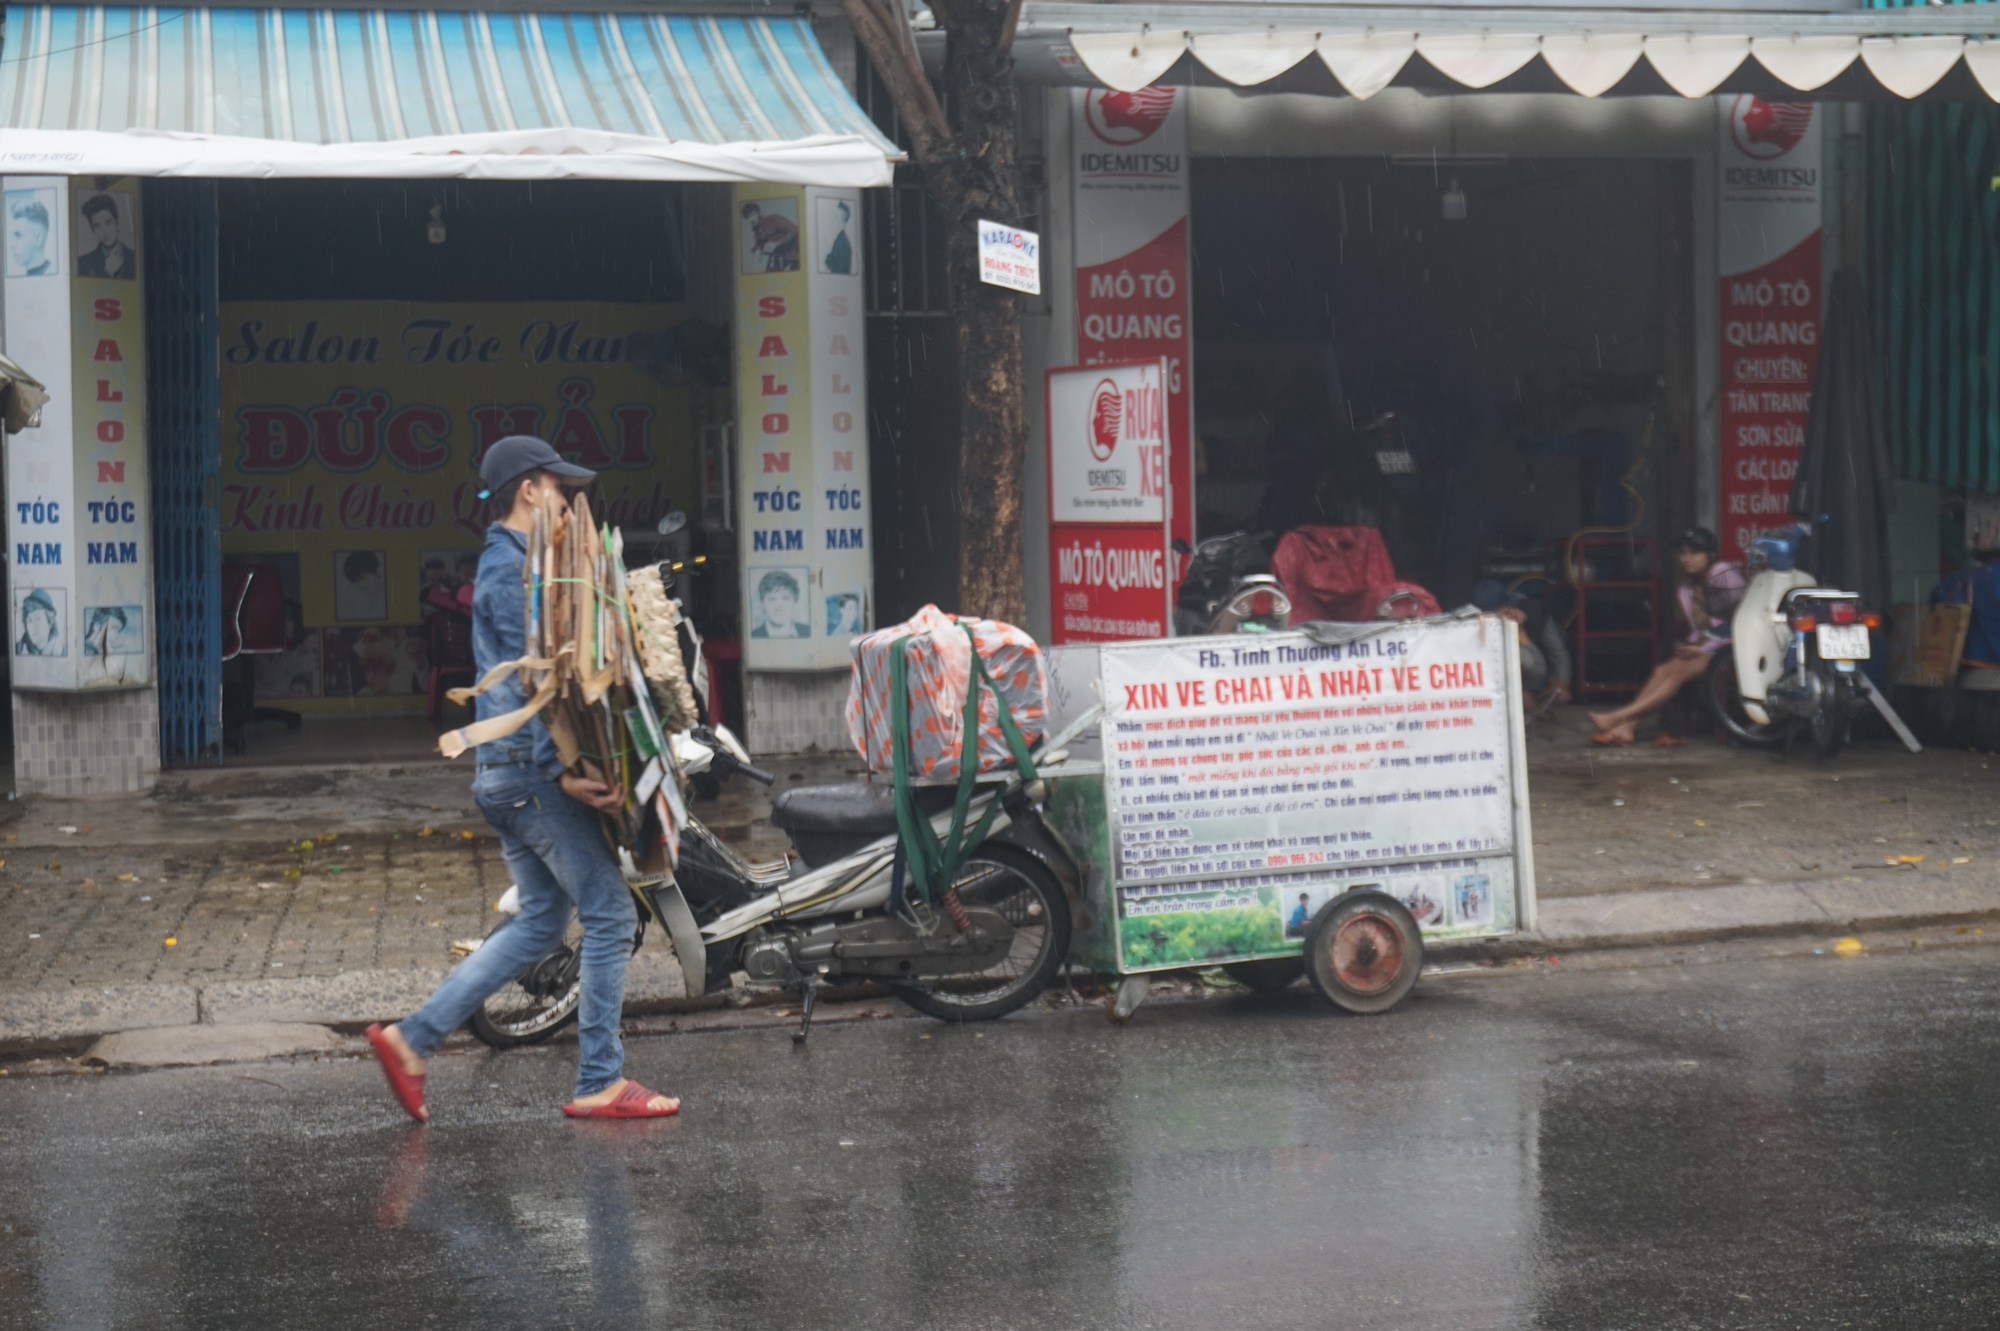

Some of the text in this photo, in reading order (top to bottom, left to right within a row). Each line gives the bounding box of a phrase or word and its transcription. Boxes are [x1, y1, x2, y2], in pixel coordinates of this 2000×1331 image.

[1081, 154, 1180, 173] IDEMITSU
[1726, 168, 1817, 186] IDEMITSU
[982, 231, 1036, 257] KARAOKE
[1090, 270, 1177, 299] MÔ TÔ
[1732, 277, 1811, 306] MÔ TÔ
[226, 318, 630, 366] Salon Tóc Na
[1084, 314, 1183, 342] QUANG
[1726, 320, 1817, 347] QUANG
[1735, 354, 1808, 380] CHUYÊN:
[94, 298, 126, 483] SALON
[758, 296, 791, 473] SALON
[828, 295, 854, 472] SALON
[1125, 367, 1162, 440] RỬA
[1729, 389, 1759, 413] TÂN
[238, 376, 656, 474] ĐỨC HẢI
[1737, 419, 1805, 447] SƠN SỬA
[1088, 470, 1127, 486] IDEMITSU
[1138, 446, 1163, 497] XE
[1737, 455, 1769, 480] CÁC
[17, 495, 60, 524] TÓC
[87, 495, 136, 524] TÓC
[222, 482, 328, 533] Kính
[337, 481, 441, 532] Chào
[753, 485, 801, 513] TÓC
[826, 484, 862, 511] TÓC
[1730, 494, 1748, 514] XE
[87, 542, 138, 564] NAM
[753, 529, 804, 552] NAM
[826, 529, 864, 550] NAM
[17, 543, 62, 565] NAM
[1059, 540, 1084, 585] MÔ
[1084, 541, 1105, 586] TÔ
[1106, 549, 1164, 592] QUANG
[1199, 650, 1226, 669] Fb.
[1276, 644, 1341, 664] Thương
[1376, 637, 1408, 661] Lạc
[1124, 661, 1484, 712] XIN VE CHAI VÀ NHẶT VE CHAI
[1267, 855, 1288, 867] 0904
